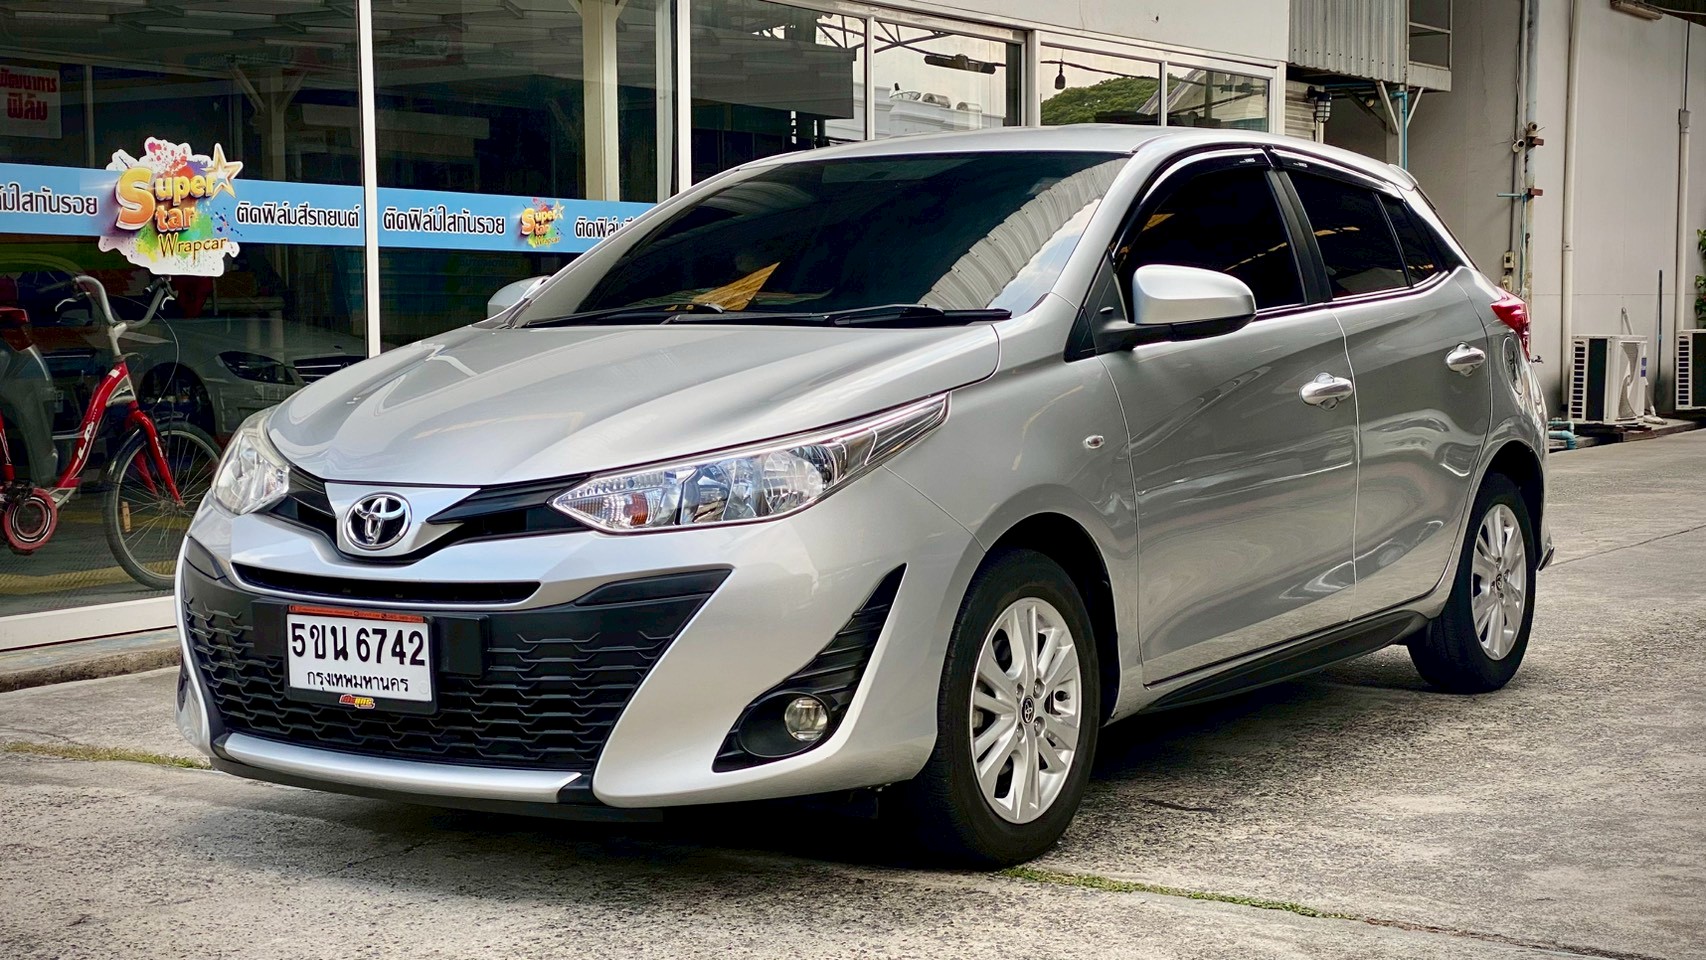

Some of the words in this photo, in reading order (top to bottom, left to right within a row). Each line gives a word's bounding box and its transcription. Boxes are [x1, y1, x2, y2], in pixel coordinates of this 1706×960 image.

[115, 167, 217, 230] Super
[236, 201, 361, 227] ติดฟิล์มสีรถยนต์
[383, 205, 505, 235] ติดฟิล์มใสกันรอย
[158, 232, 228, 260] Wrapcar
[291, 623, 349, 662] 5ขน
[356, 627, 426, 667] 6742
[307, 671, 409, 693] กรุงเทพมหานคร
